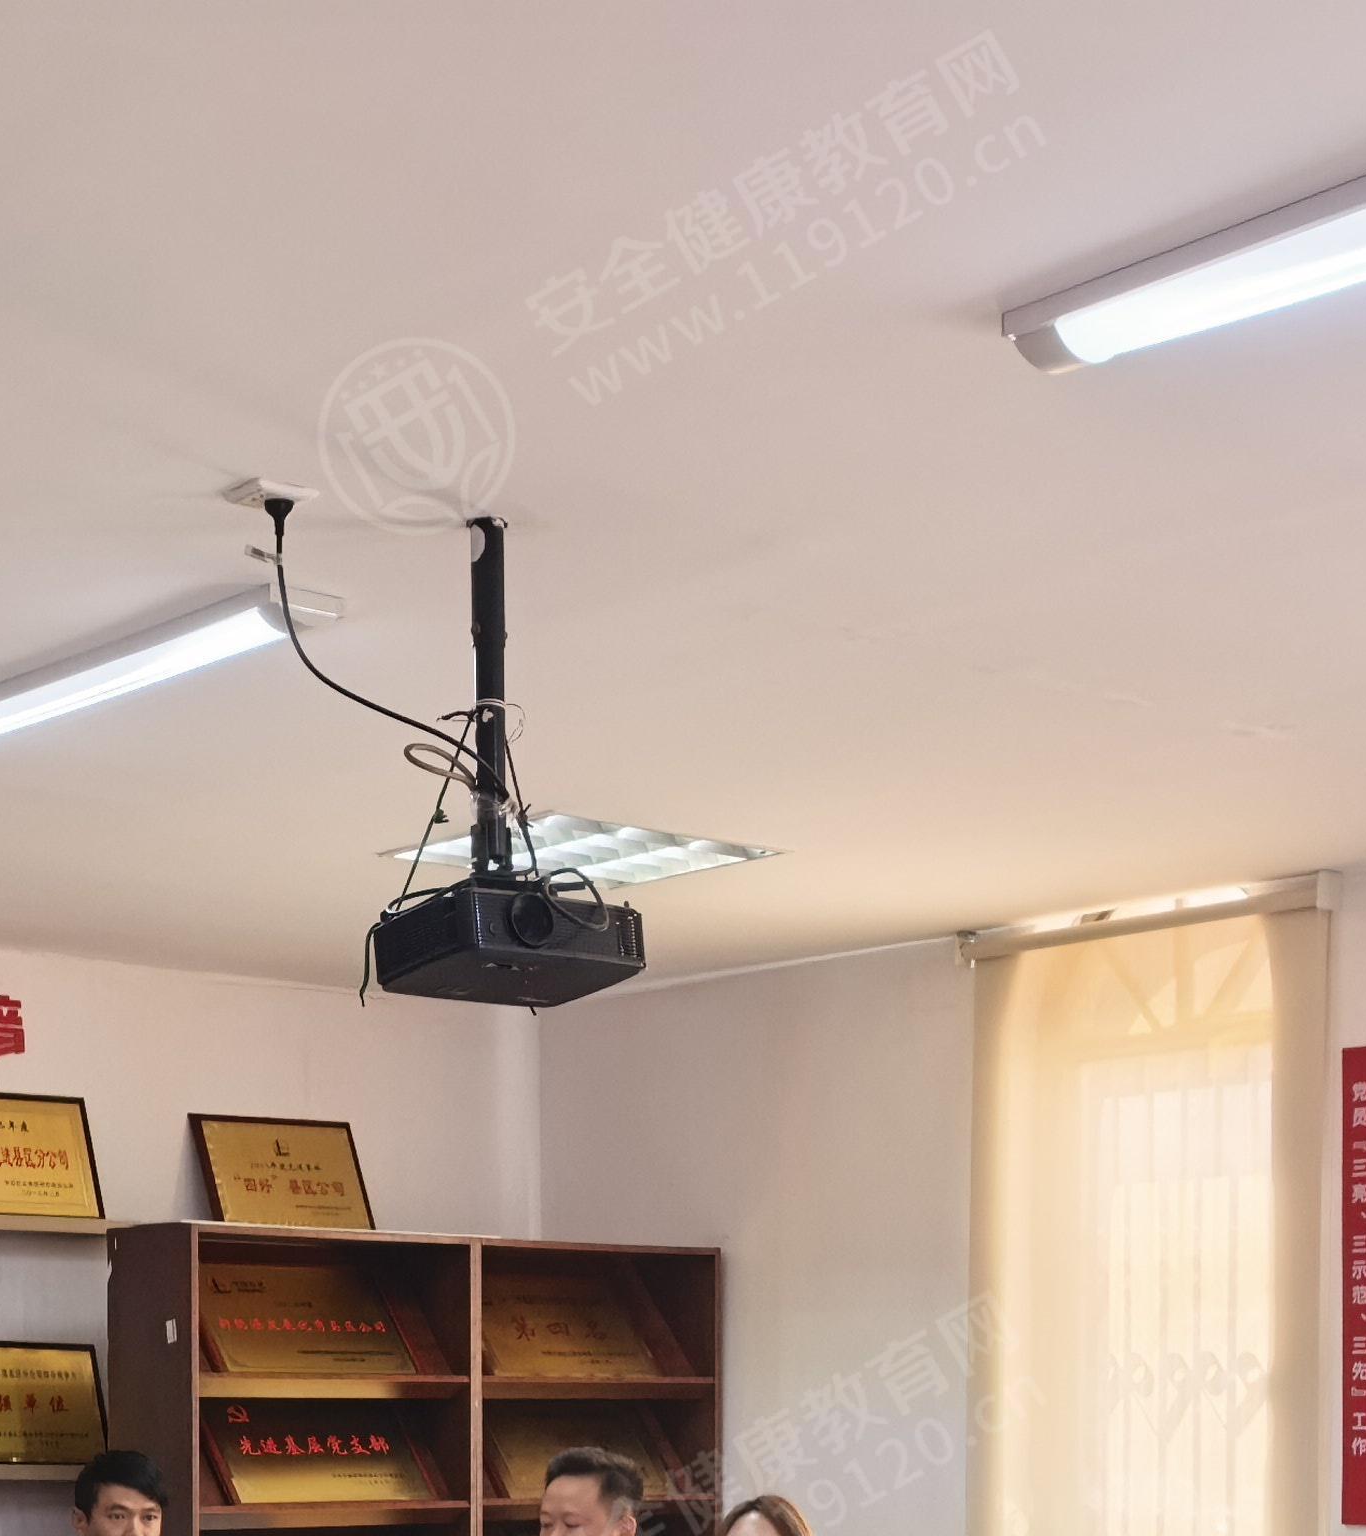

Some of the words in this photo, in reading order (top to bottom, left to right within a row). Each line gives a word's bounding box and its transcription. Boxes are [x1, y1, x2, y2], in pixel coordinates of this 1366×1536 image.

[240, 1434, 390, 1456] 先进基层党支部
